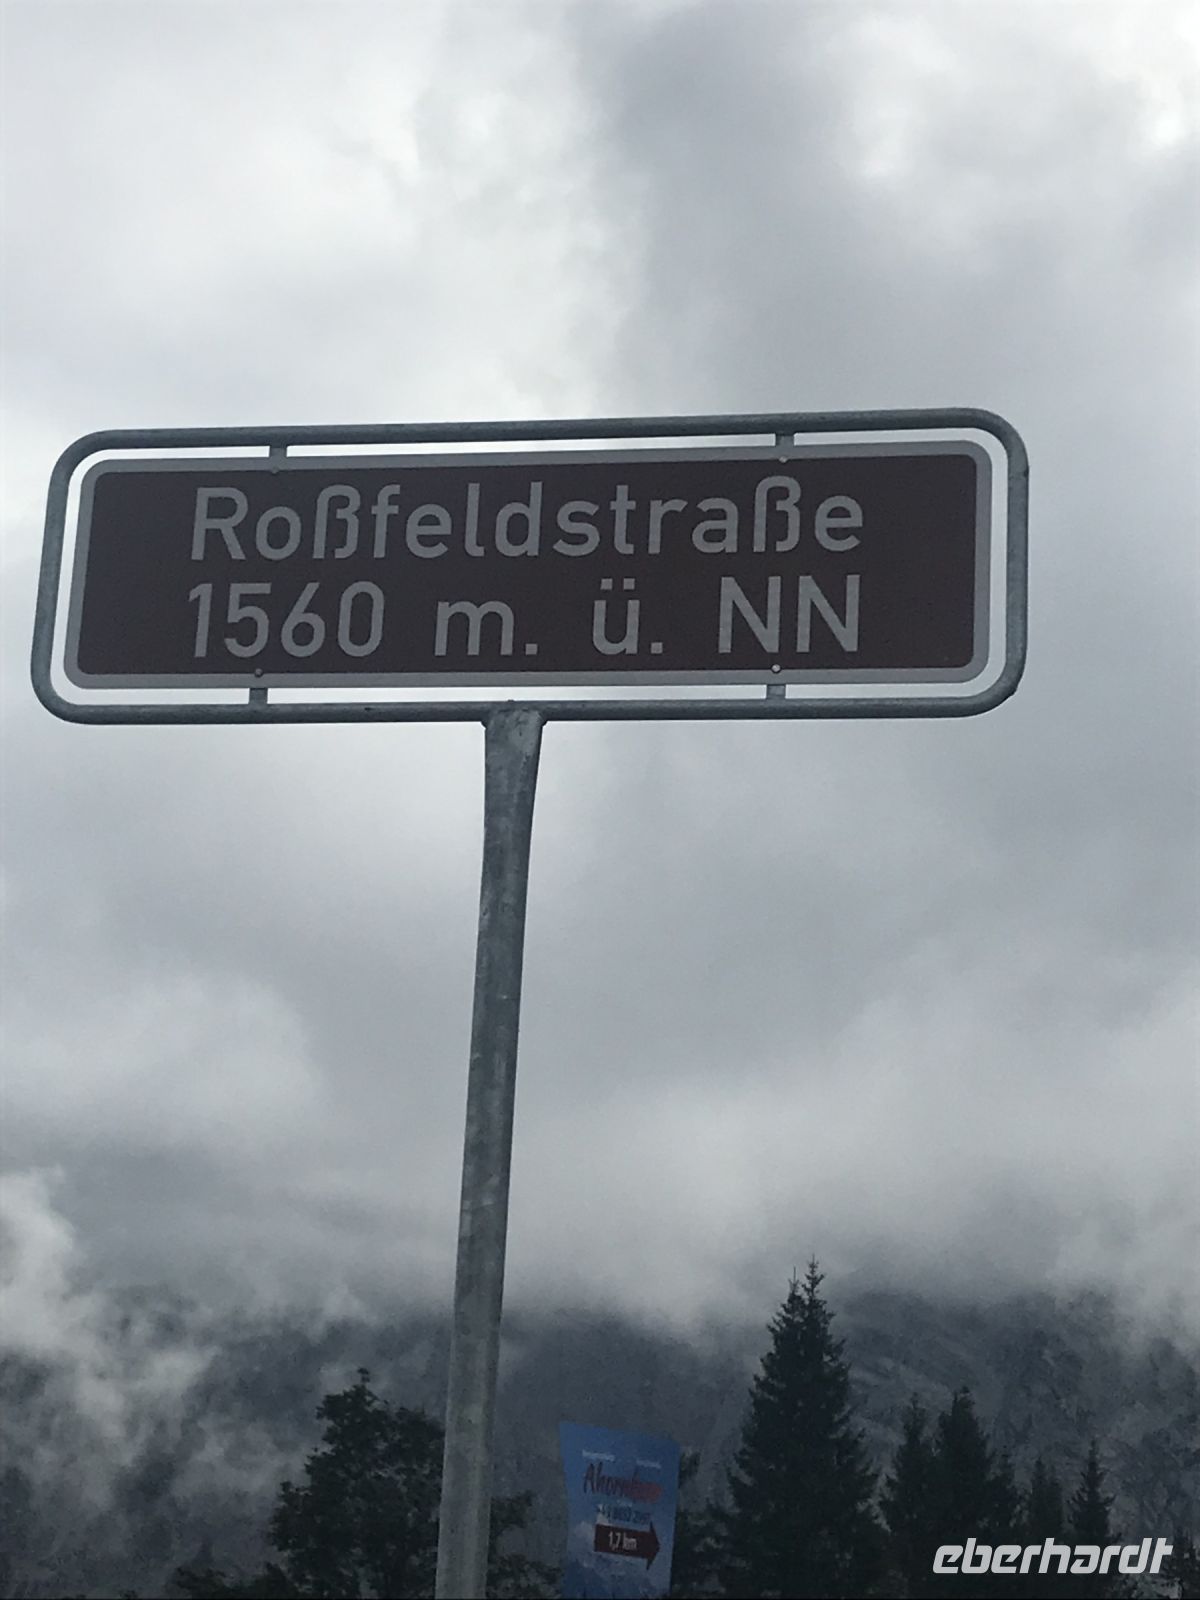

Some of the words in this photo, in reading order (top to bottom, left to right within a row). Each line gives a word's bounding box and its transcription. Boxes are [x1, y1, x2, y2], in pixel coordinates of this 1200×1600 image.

[191, 476, 863, 562] Roßfeldstraße
[189, 580, 384, 659] 1560
[434, 600, 538, 657] m.
[592, 577, 663, 656] ü.
[718, 574, 860, 655] NN
[622, 1532, 638, 1551] km
